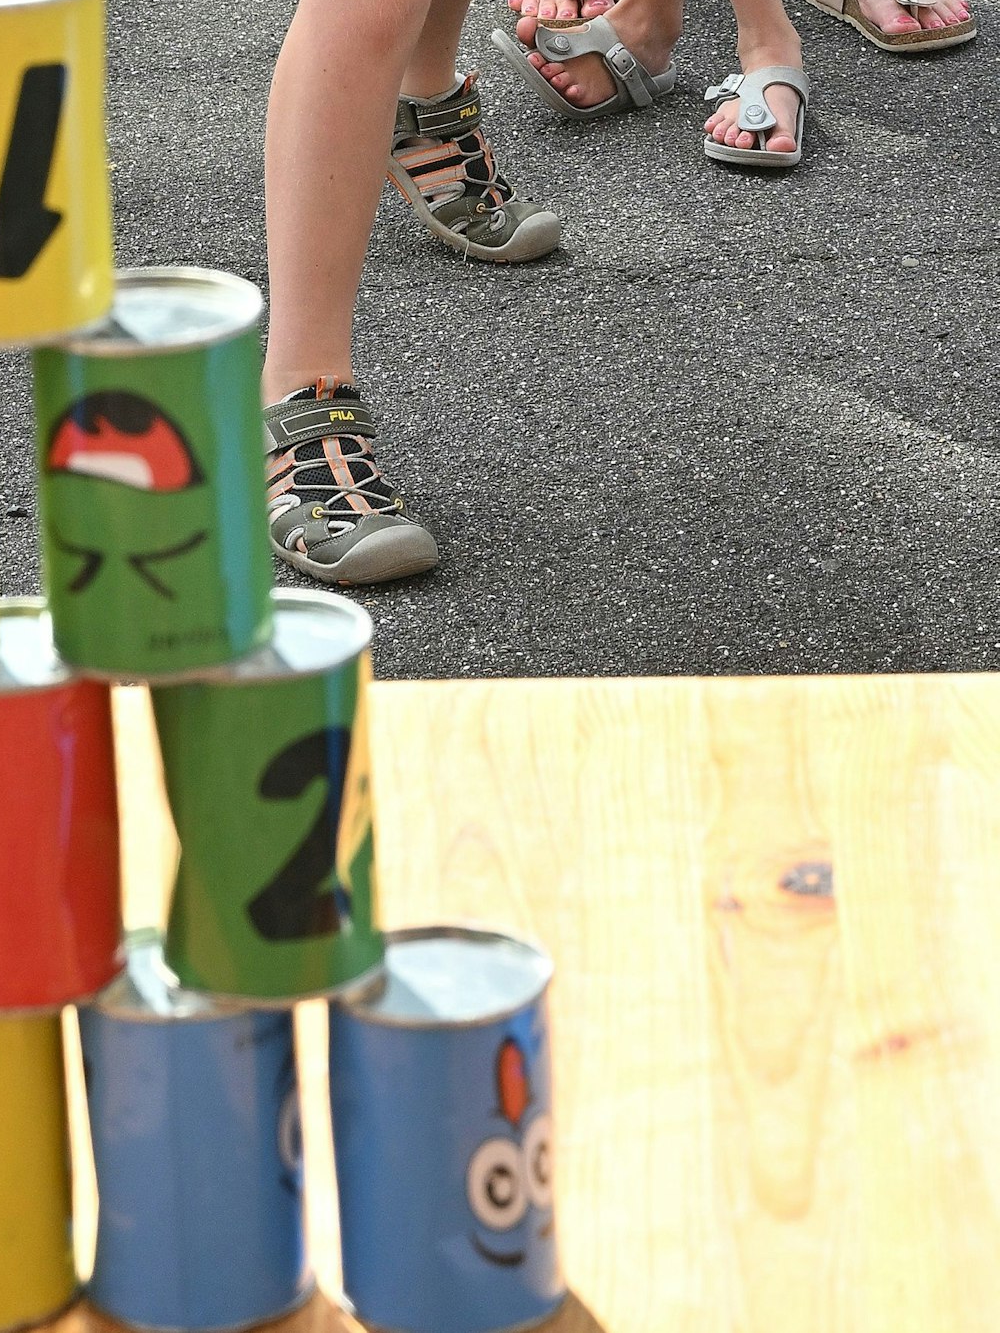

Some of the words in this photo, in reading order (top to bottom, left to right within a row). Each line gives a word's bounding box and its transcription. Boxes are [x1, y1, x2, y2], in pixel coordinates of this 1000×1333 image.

[459, 105, 478, 119] FILA
[329, 410, 355, 422] FILA
[247, 726, 353, 941] 2
